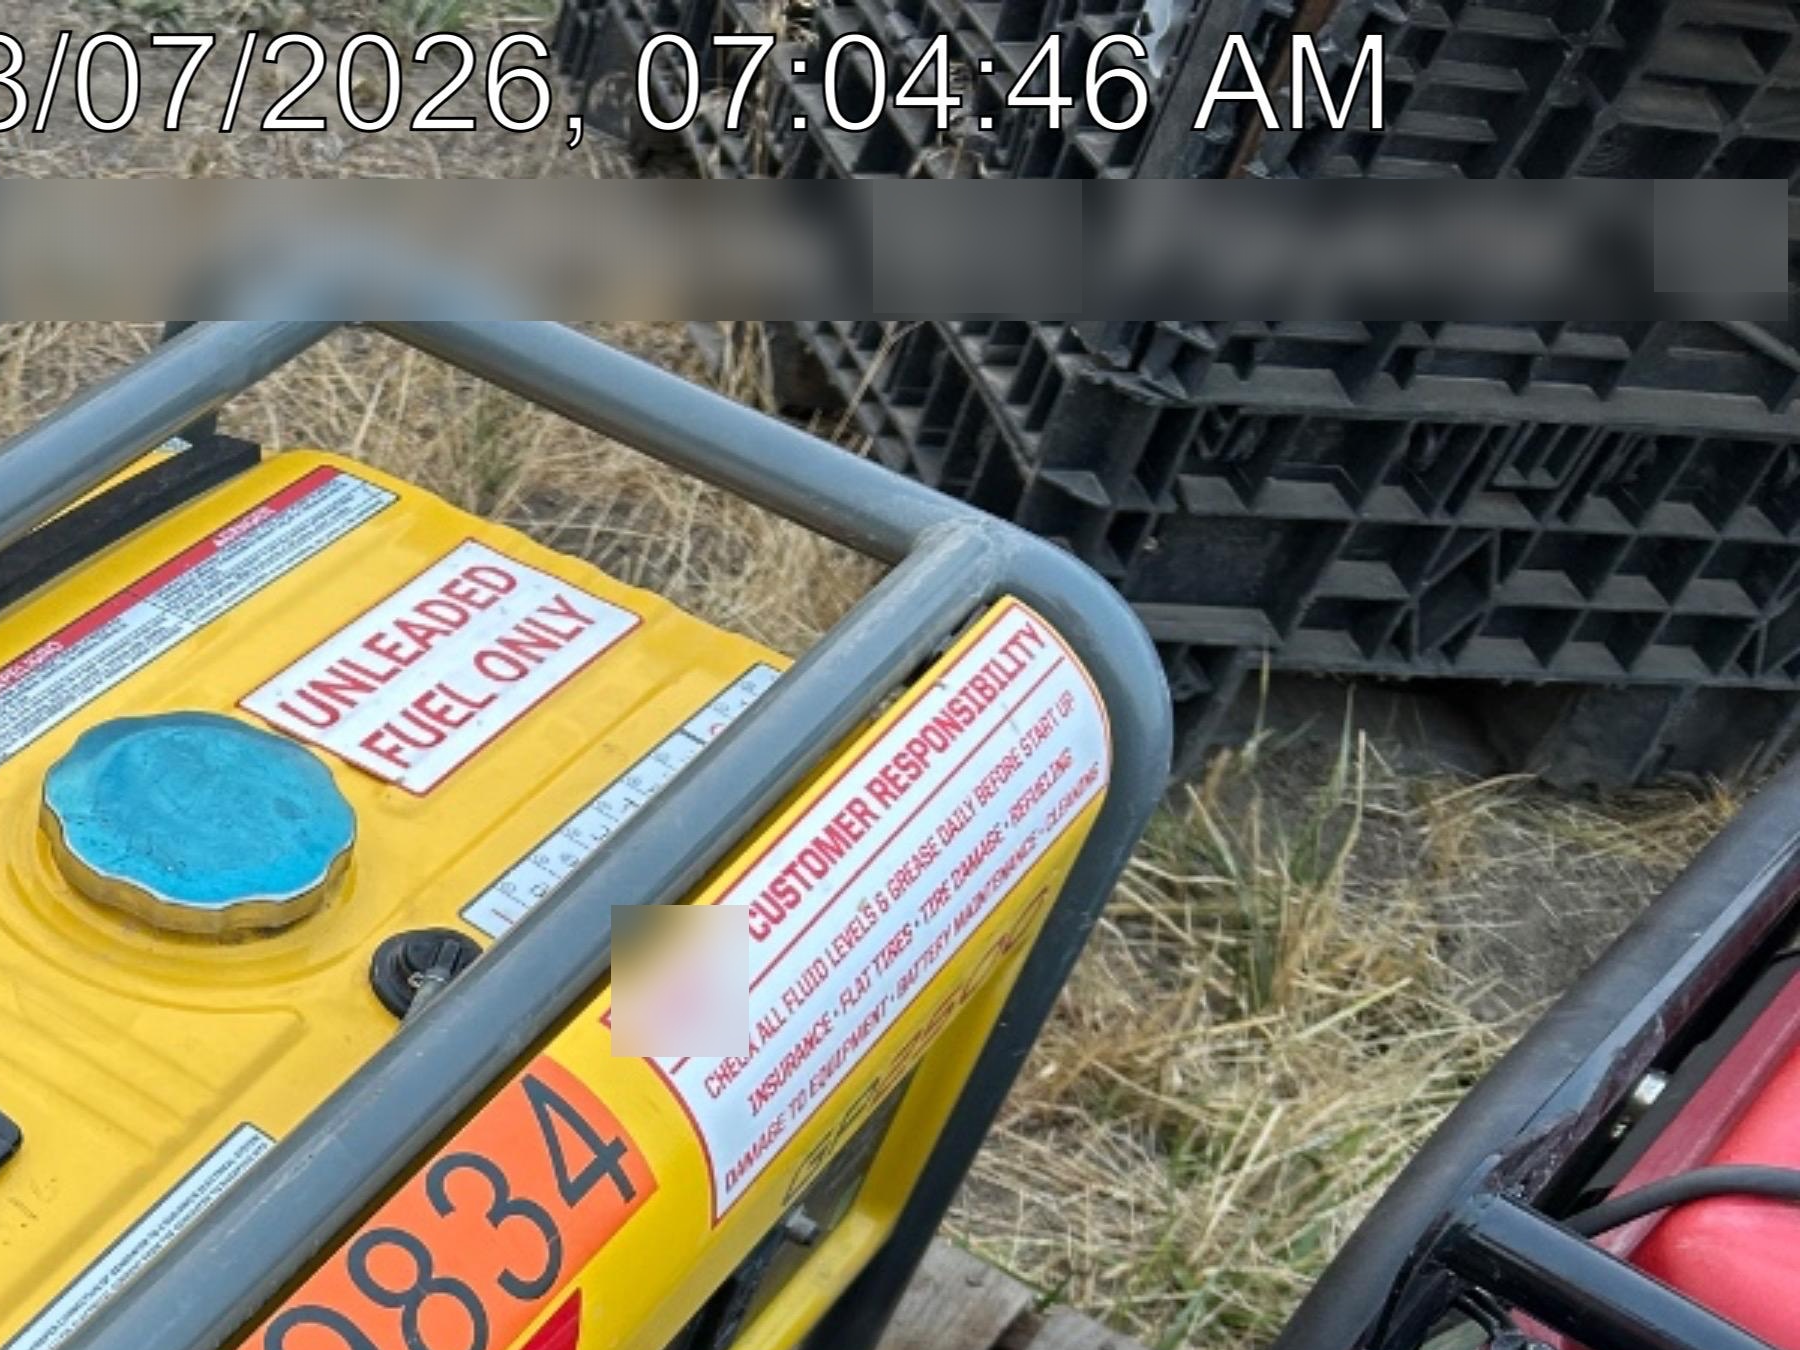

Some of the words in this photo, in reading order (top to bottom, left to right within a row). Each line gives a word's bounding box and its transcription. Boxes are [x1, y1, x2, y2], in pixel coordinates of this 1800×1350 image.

[278, 564, 518, 732] UNLEADED
[359, 680, 496, 770] FUEL
[472, 594, 596, 687] ONLY
[748, 793, 886, 943] CUSTOMER
[863, 621, 1046, 811] RESPONSIBILITY
[725, 1115, 788, 1195] DAMAGE
[788, 1088, 809, 1123] TO
[808, 993, 891, 1100] EQUIPMENT
[893, 922, 953, 1003] BATTERY
[951, 828, 1038, 936] MAINTENANCE
[746, 1011, 834, 1118] INSURANCE
[838, 964, 874, 1017] FLAT
[871, 922, 916, 981] TIRES
[918, 878, 952, 925] TIRE
[950, 821, 1005, 892] DAMAGE
[1008, 746, 1074, 825] REFUELING
[756, 1007, 788, 1047] ALL
[780, 954, 830, 1025] FLUID
[827, 901, 881, 969] LEVELS
[886, 836, 943, 900] GREASE
[935, 796, 978, 848] DAILY
[973, 746, 1024, 808] BEFORE
[1019, 706, 1059, 758] START
[1055, 689, 1077, 721] UP
